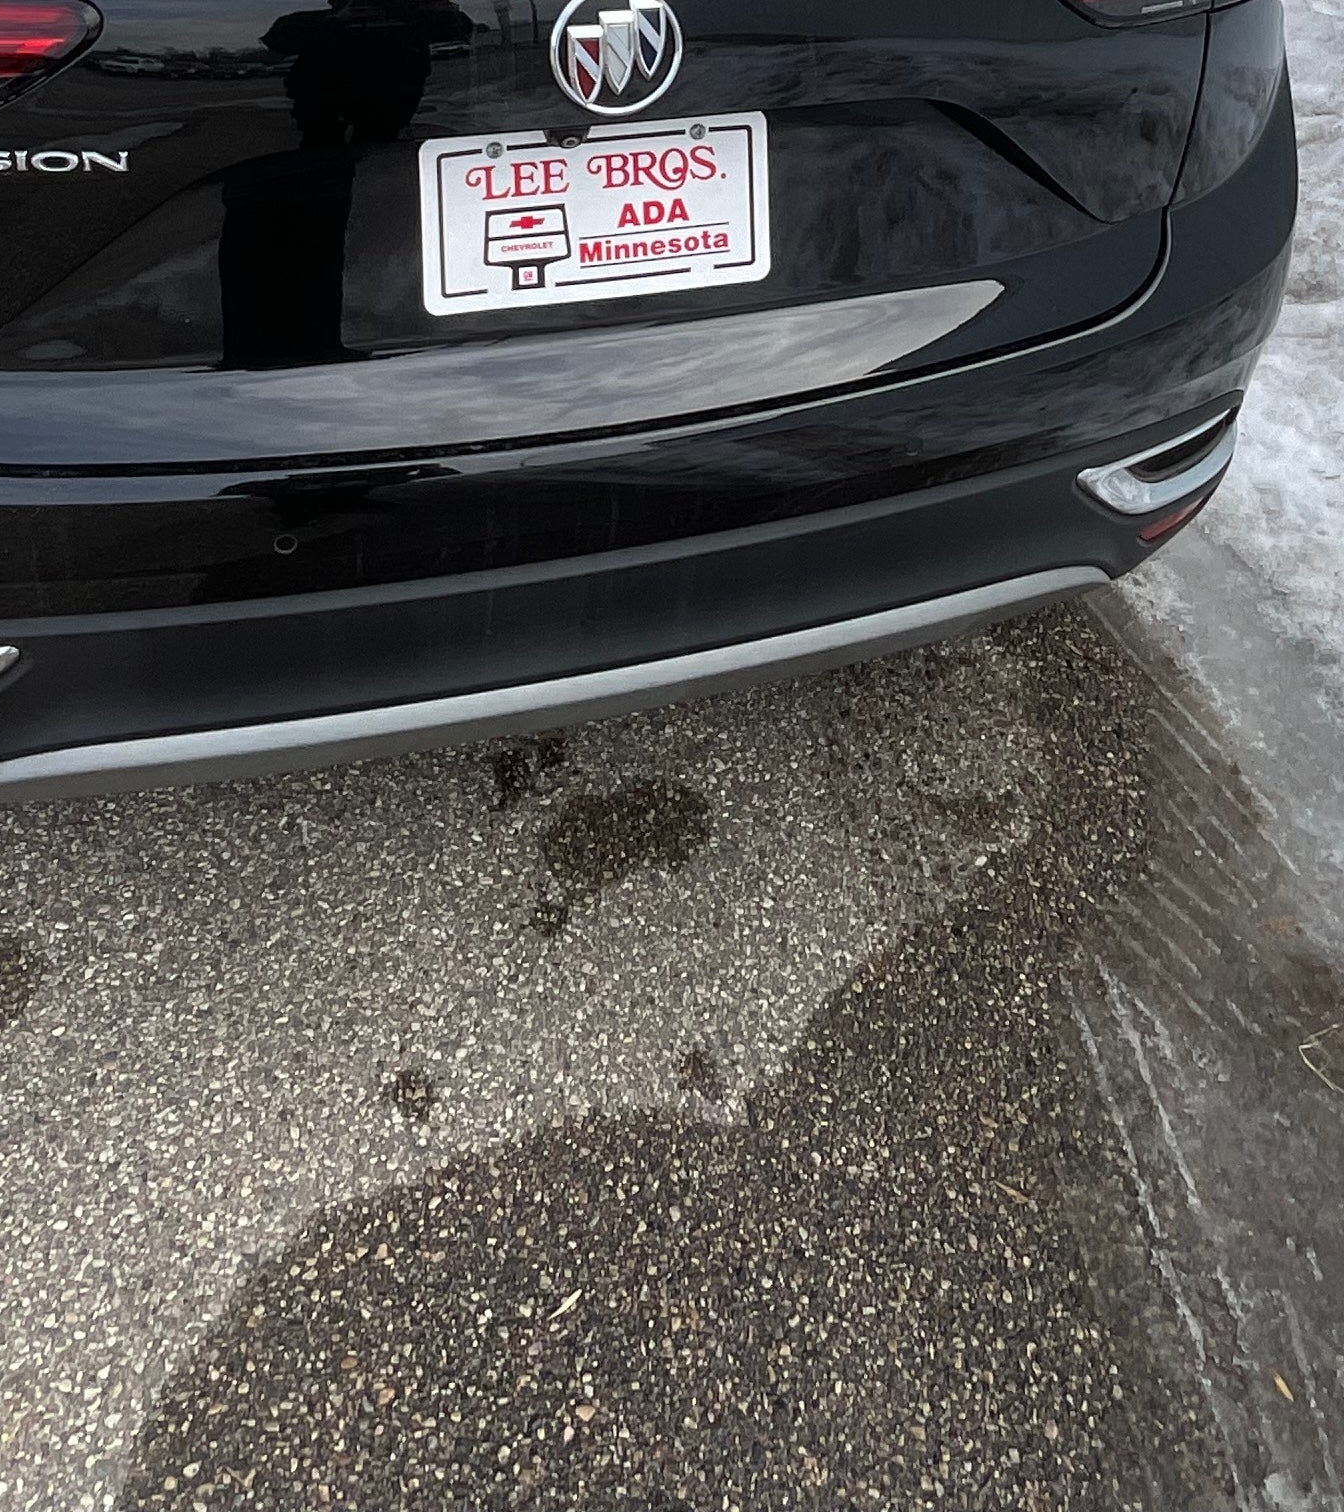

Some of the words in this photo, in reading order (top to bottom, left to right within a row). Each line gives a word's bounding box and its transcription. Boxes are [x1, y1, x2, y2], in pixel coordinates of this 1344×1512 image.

[465, 158, 570, 200] LEE
[586, 145, 727, 191] BROS.
[617, 198, 690, 229] ADA
[500, 241, 554, 253] CHEVROLET
[578, 230, 729, 265] Minnesota
